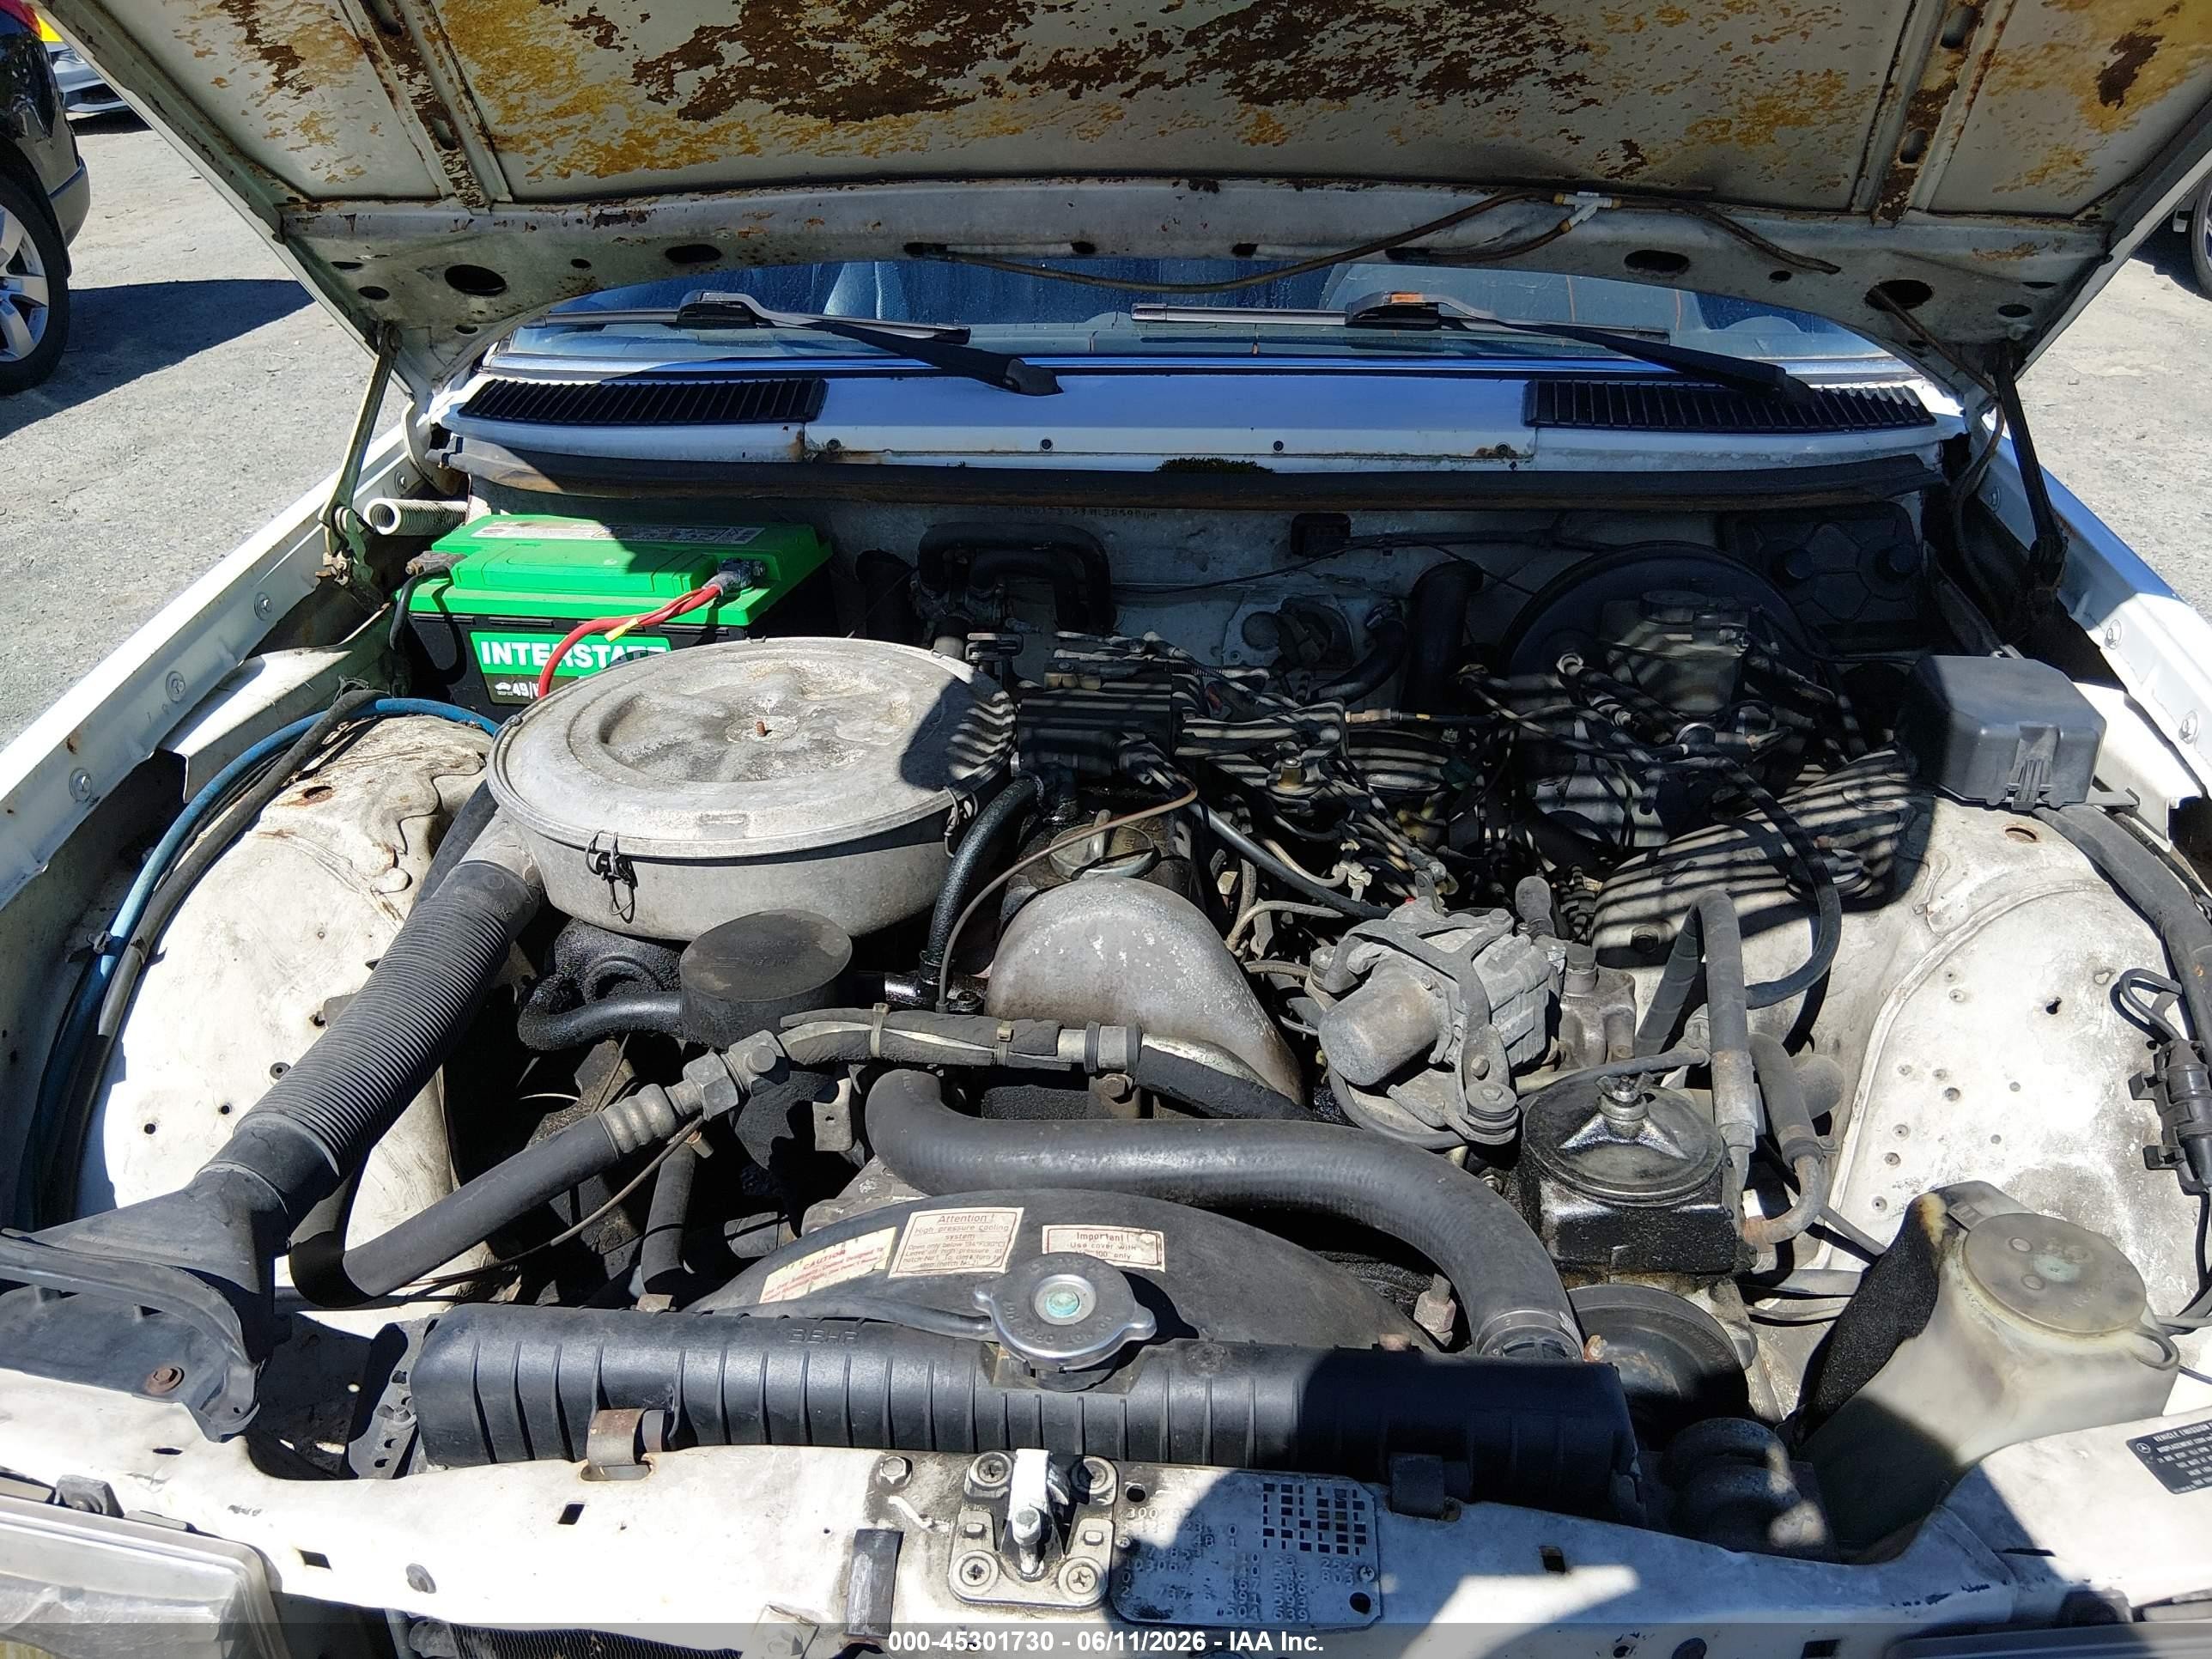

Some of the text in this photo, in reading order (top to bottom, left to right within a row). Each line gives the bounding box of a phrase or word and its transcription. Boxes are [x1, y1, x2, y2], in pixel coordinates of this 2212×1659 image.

[938, 1213, 988, 1224] Attention
[915, 1224, 1009, 1235] High pressure cooling
[945, 1233, 975, 1242] system
[1077, 1231, 1124, 1242] Important
[803, 1249, 846, 1270] CAUTION
[1126, 1507, 1158, 1519] 300
